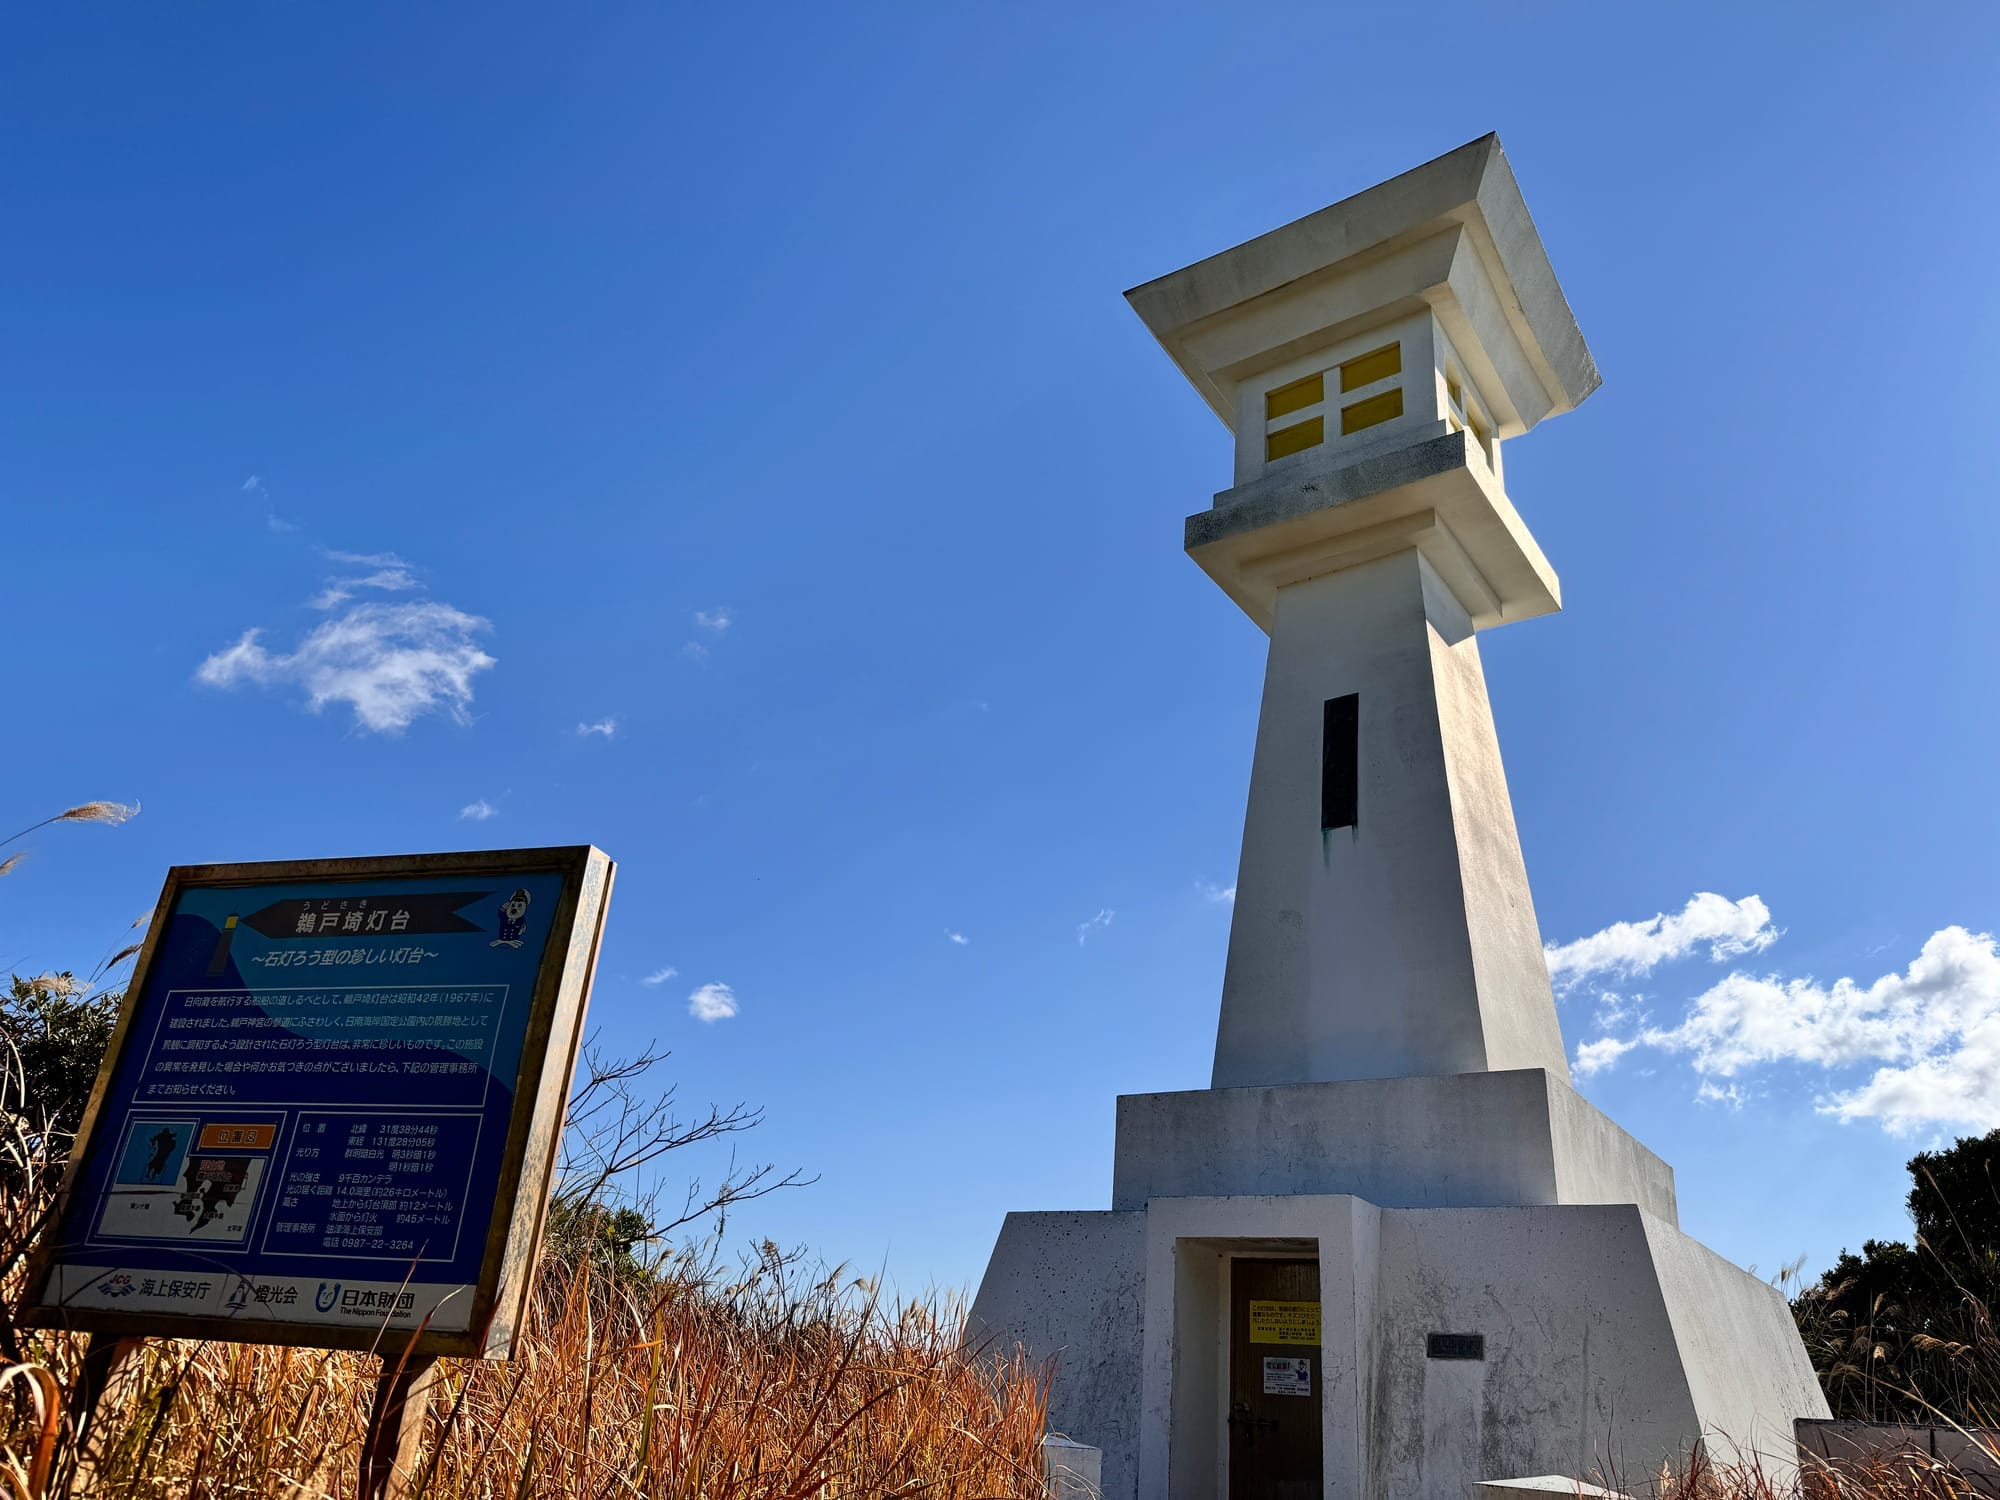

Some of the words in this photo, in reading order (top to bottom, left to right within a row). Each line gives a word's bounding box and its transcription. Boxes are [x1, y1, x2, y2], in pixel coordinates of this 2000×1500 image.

[109, 1273, 131, 1285] JCG
[139, 1278, 212, 1300] 海上保安庁
[341, 1289, 415, 1309] 日本財団
[340, 1306, 351, 1315] The
[352, 1307, 374, 1317] Nippon
